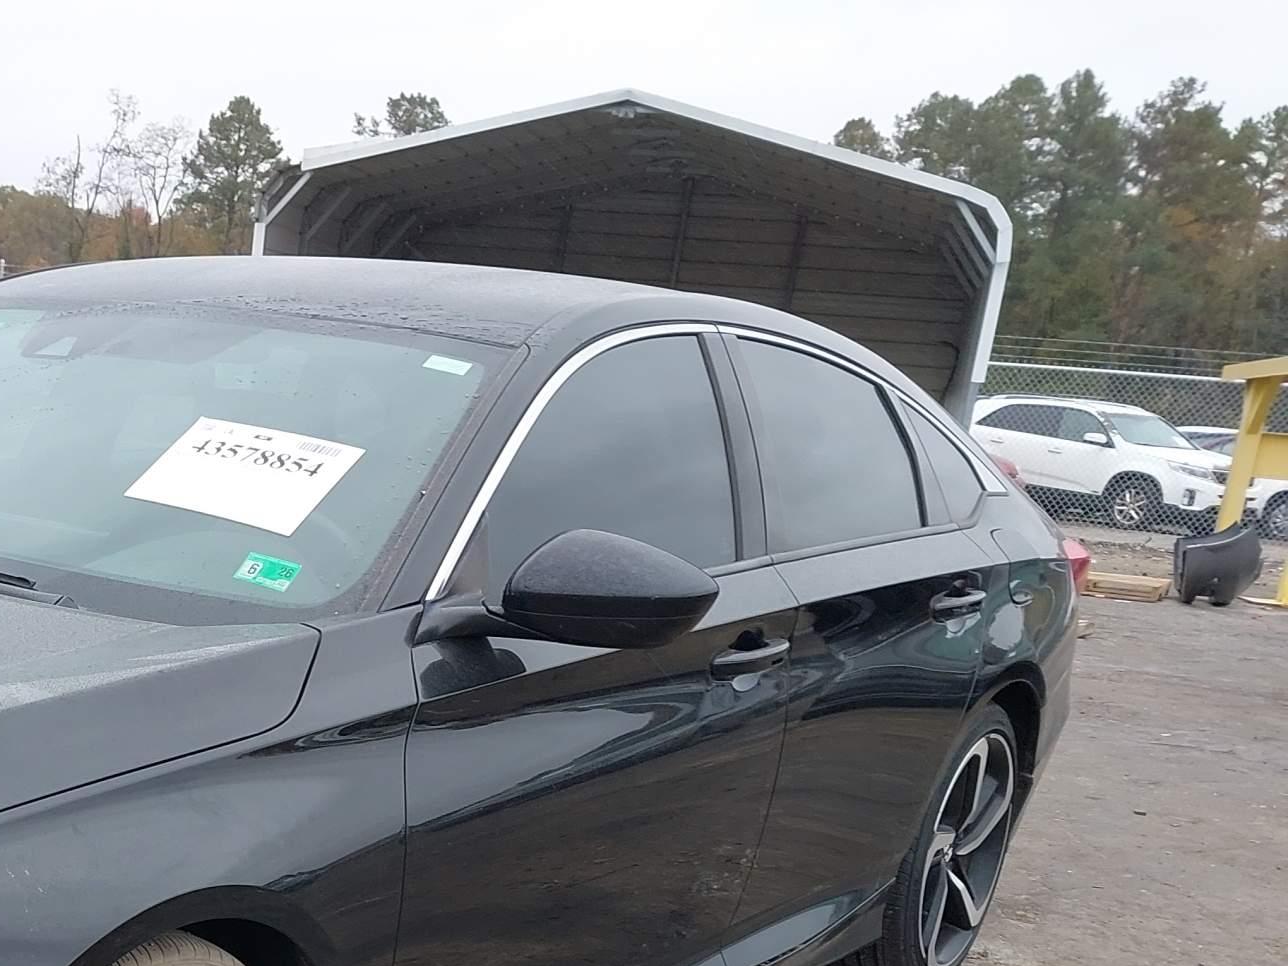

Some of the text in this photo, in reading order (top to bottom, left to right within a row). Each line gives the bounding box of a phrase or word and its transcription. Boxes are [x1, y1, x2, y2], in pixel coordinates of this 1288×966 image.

[192, 439, 325, 477] 43578854
[247, 563, 295, 579] 6 26
